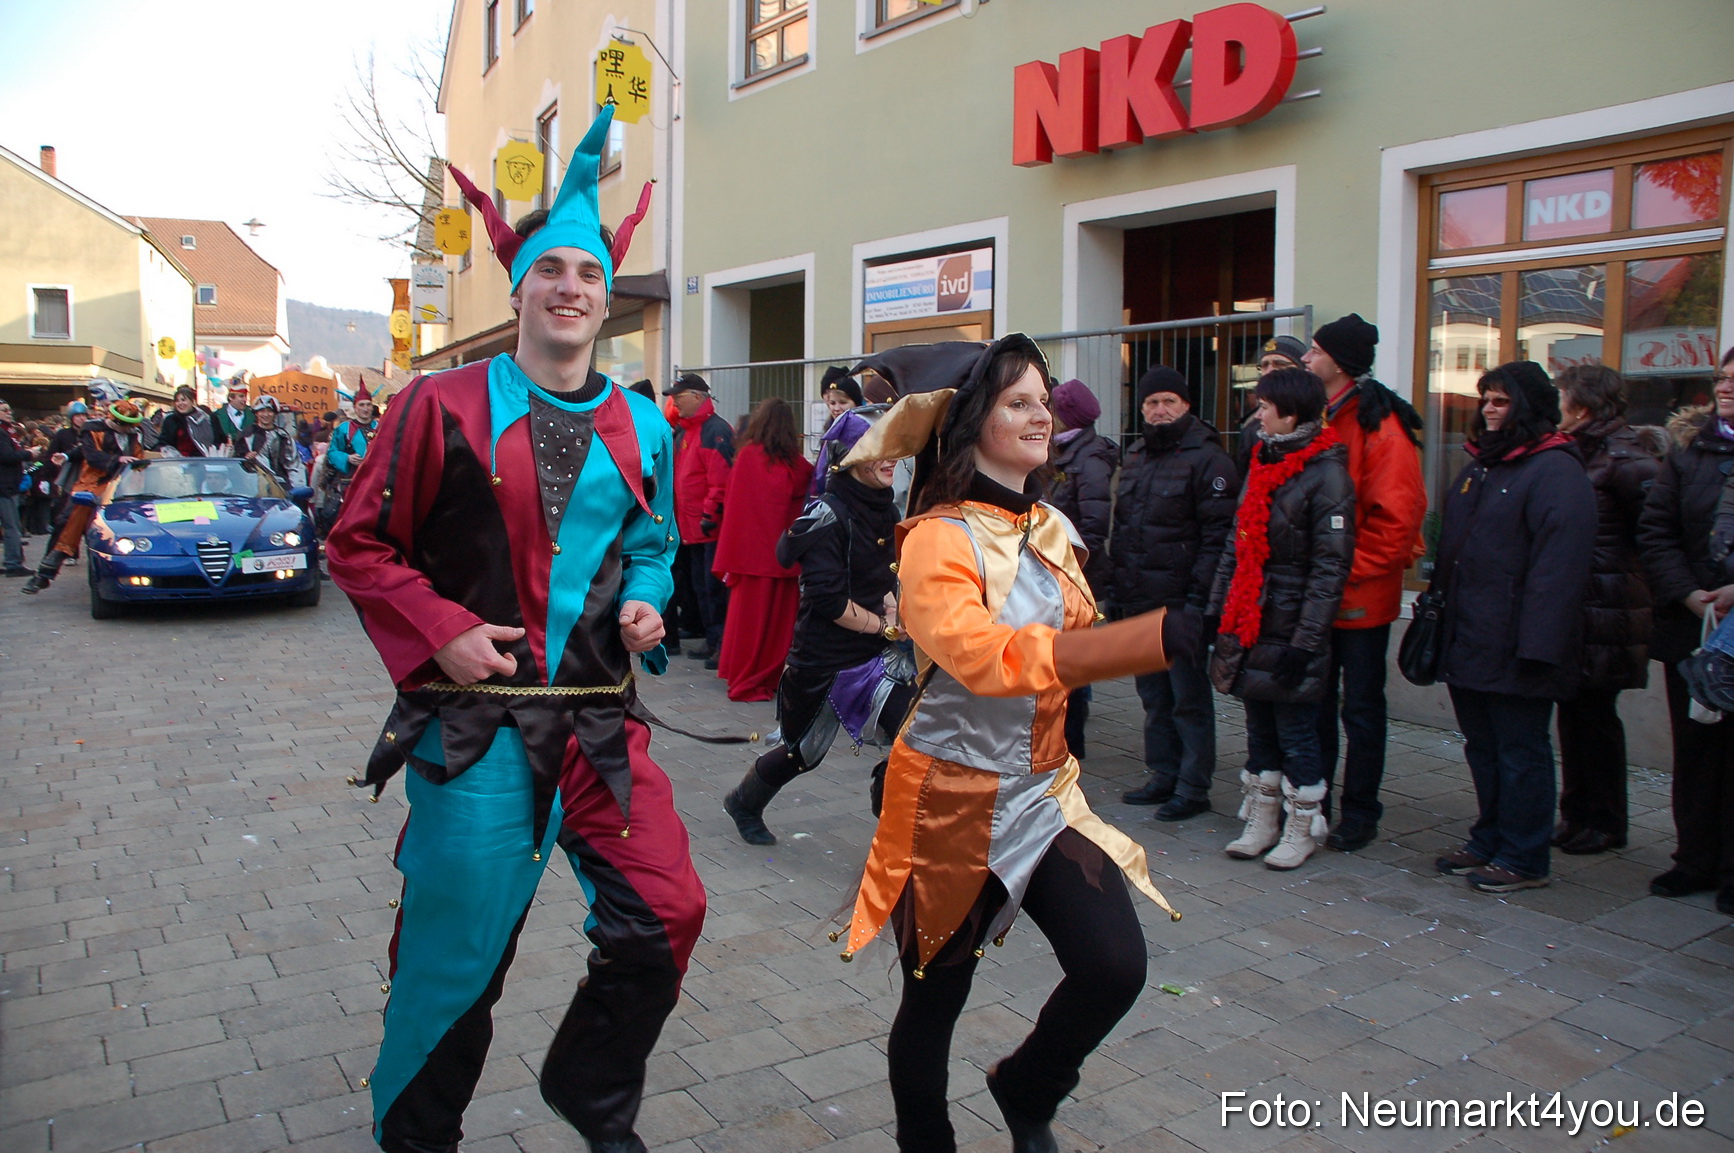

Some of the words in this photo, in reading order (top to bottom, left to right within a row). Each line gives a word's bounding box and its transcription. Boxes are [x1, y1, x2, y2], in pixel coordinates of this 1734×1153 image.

[1013, 2, 1298, 168] NKD
[1528, 190, 1612, 226] NKD
[940, 271, 969, 296] ivd
[258, 381, 328, 395] Karlsson
